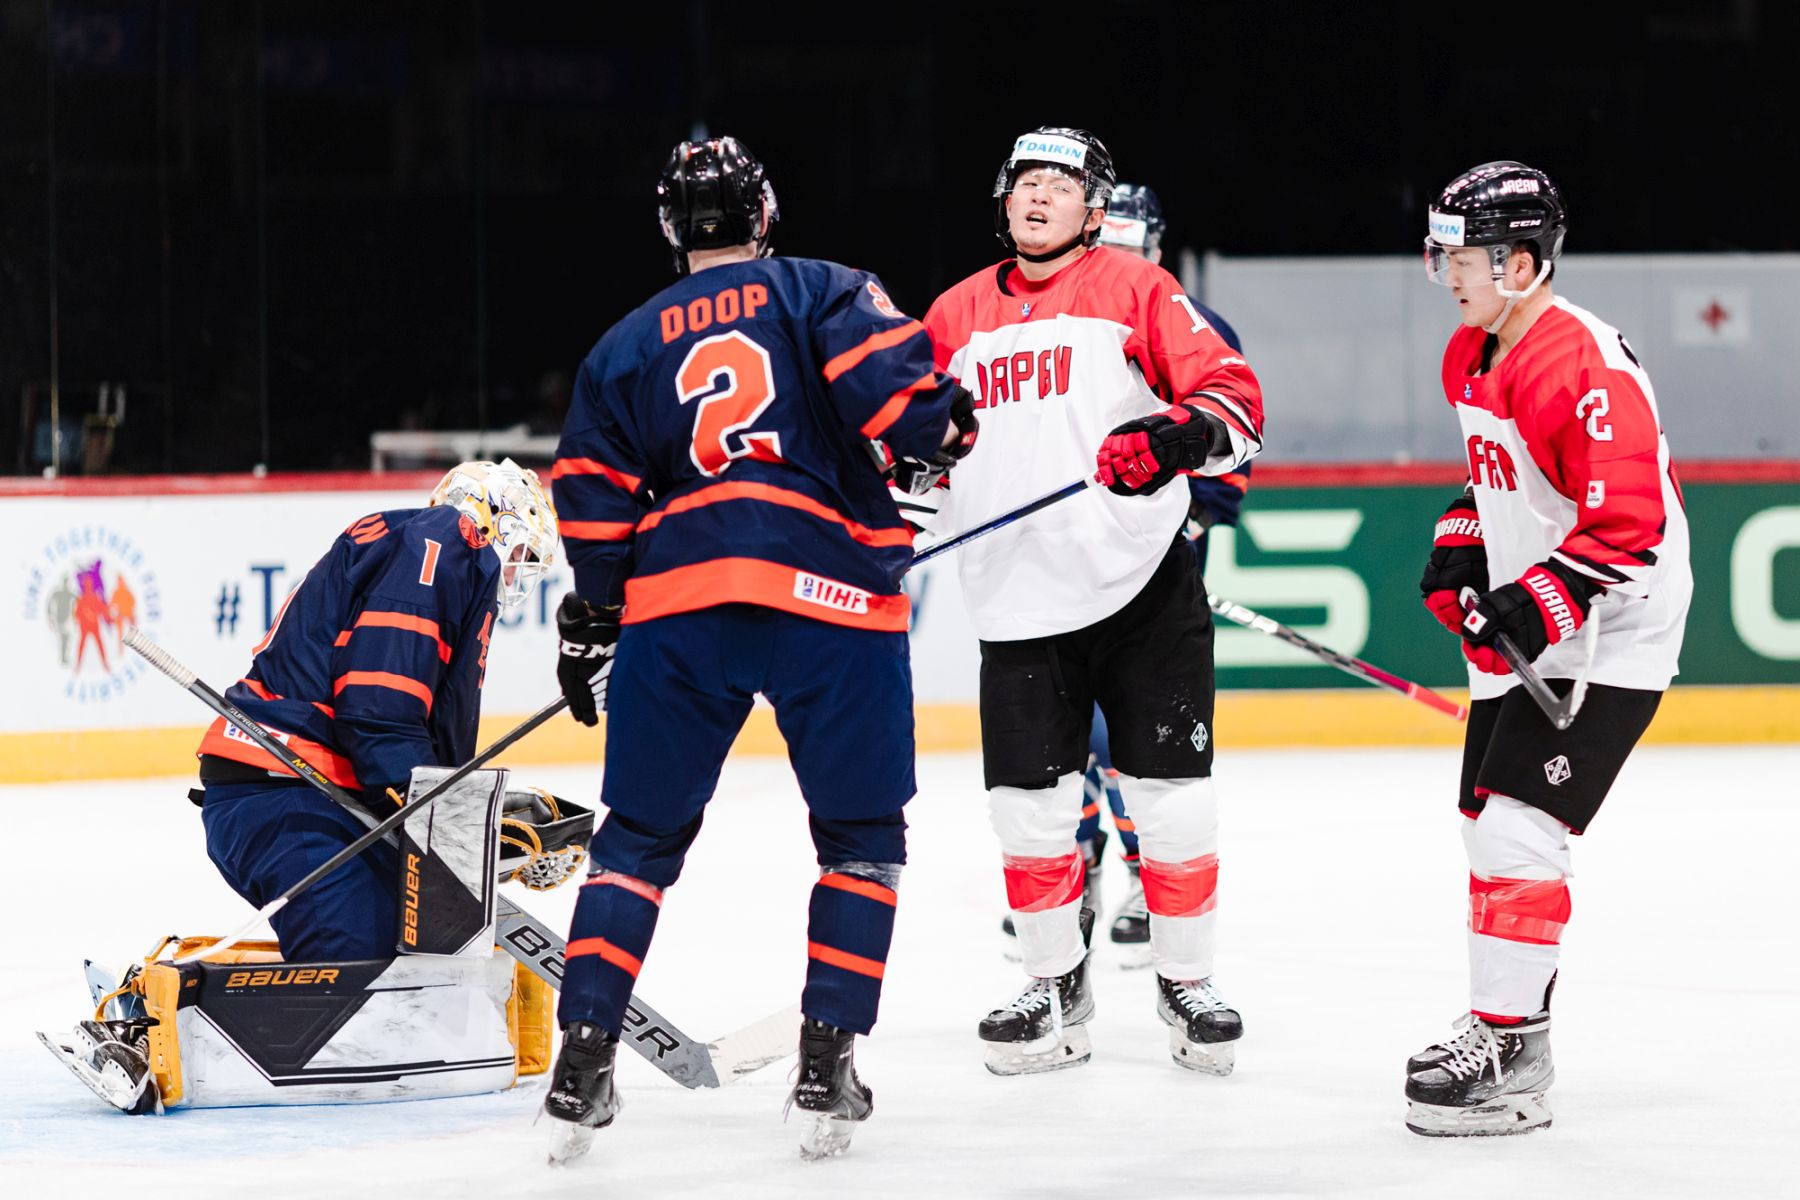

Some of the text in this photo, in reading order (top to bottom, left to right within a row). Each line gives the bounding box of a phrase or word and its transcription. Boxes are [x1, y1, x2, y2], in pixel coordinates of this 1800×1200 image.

[1027, 141, 1083, 160] DAIKIN
[1499, 178, 1541, 196] JAPAN
[1508, 219, 1541, 228] CCM
[660, 283, 769, 345] DOOP
[866, 280, 906, 319] 2
[1170, 293, 1216, 336] 1
[675, 329, 788, 479] 2
[1575, 388, 1613, 442] 2
[418, 537, 442, 587] 1
[816, 581, 863, 610] IIHF
[560, 639, 618, 659] CM
[404, 853, 421, 947] BAUER
[225, 968, 340, 988] BAUER
